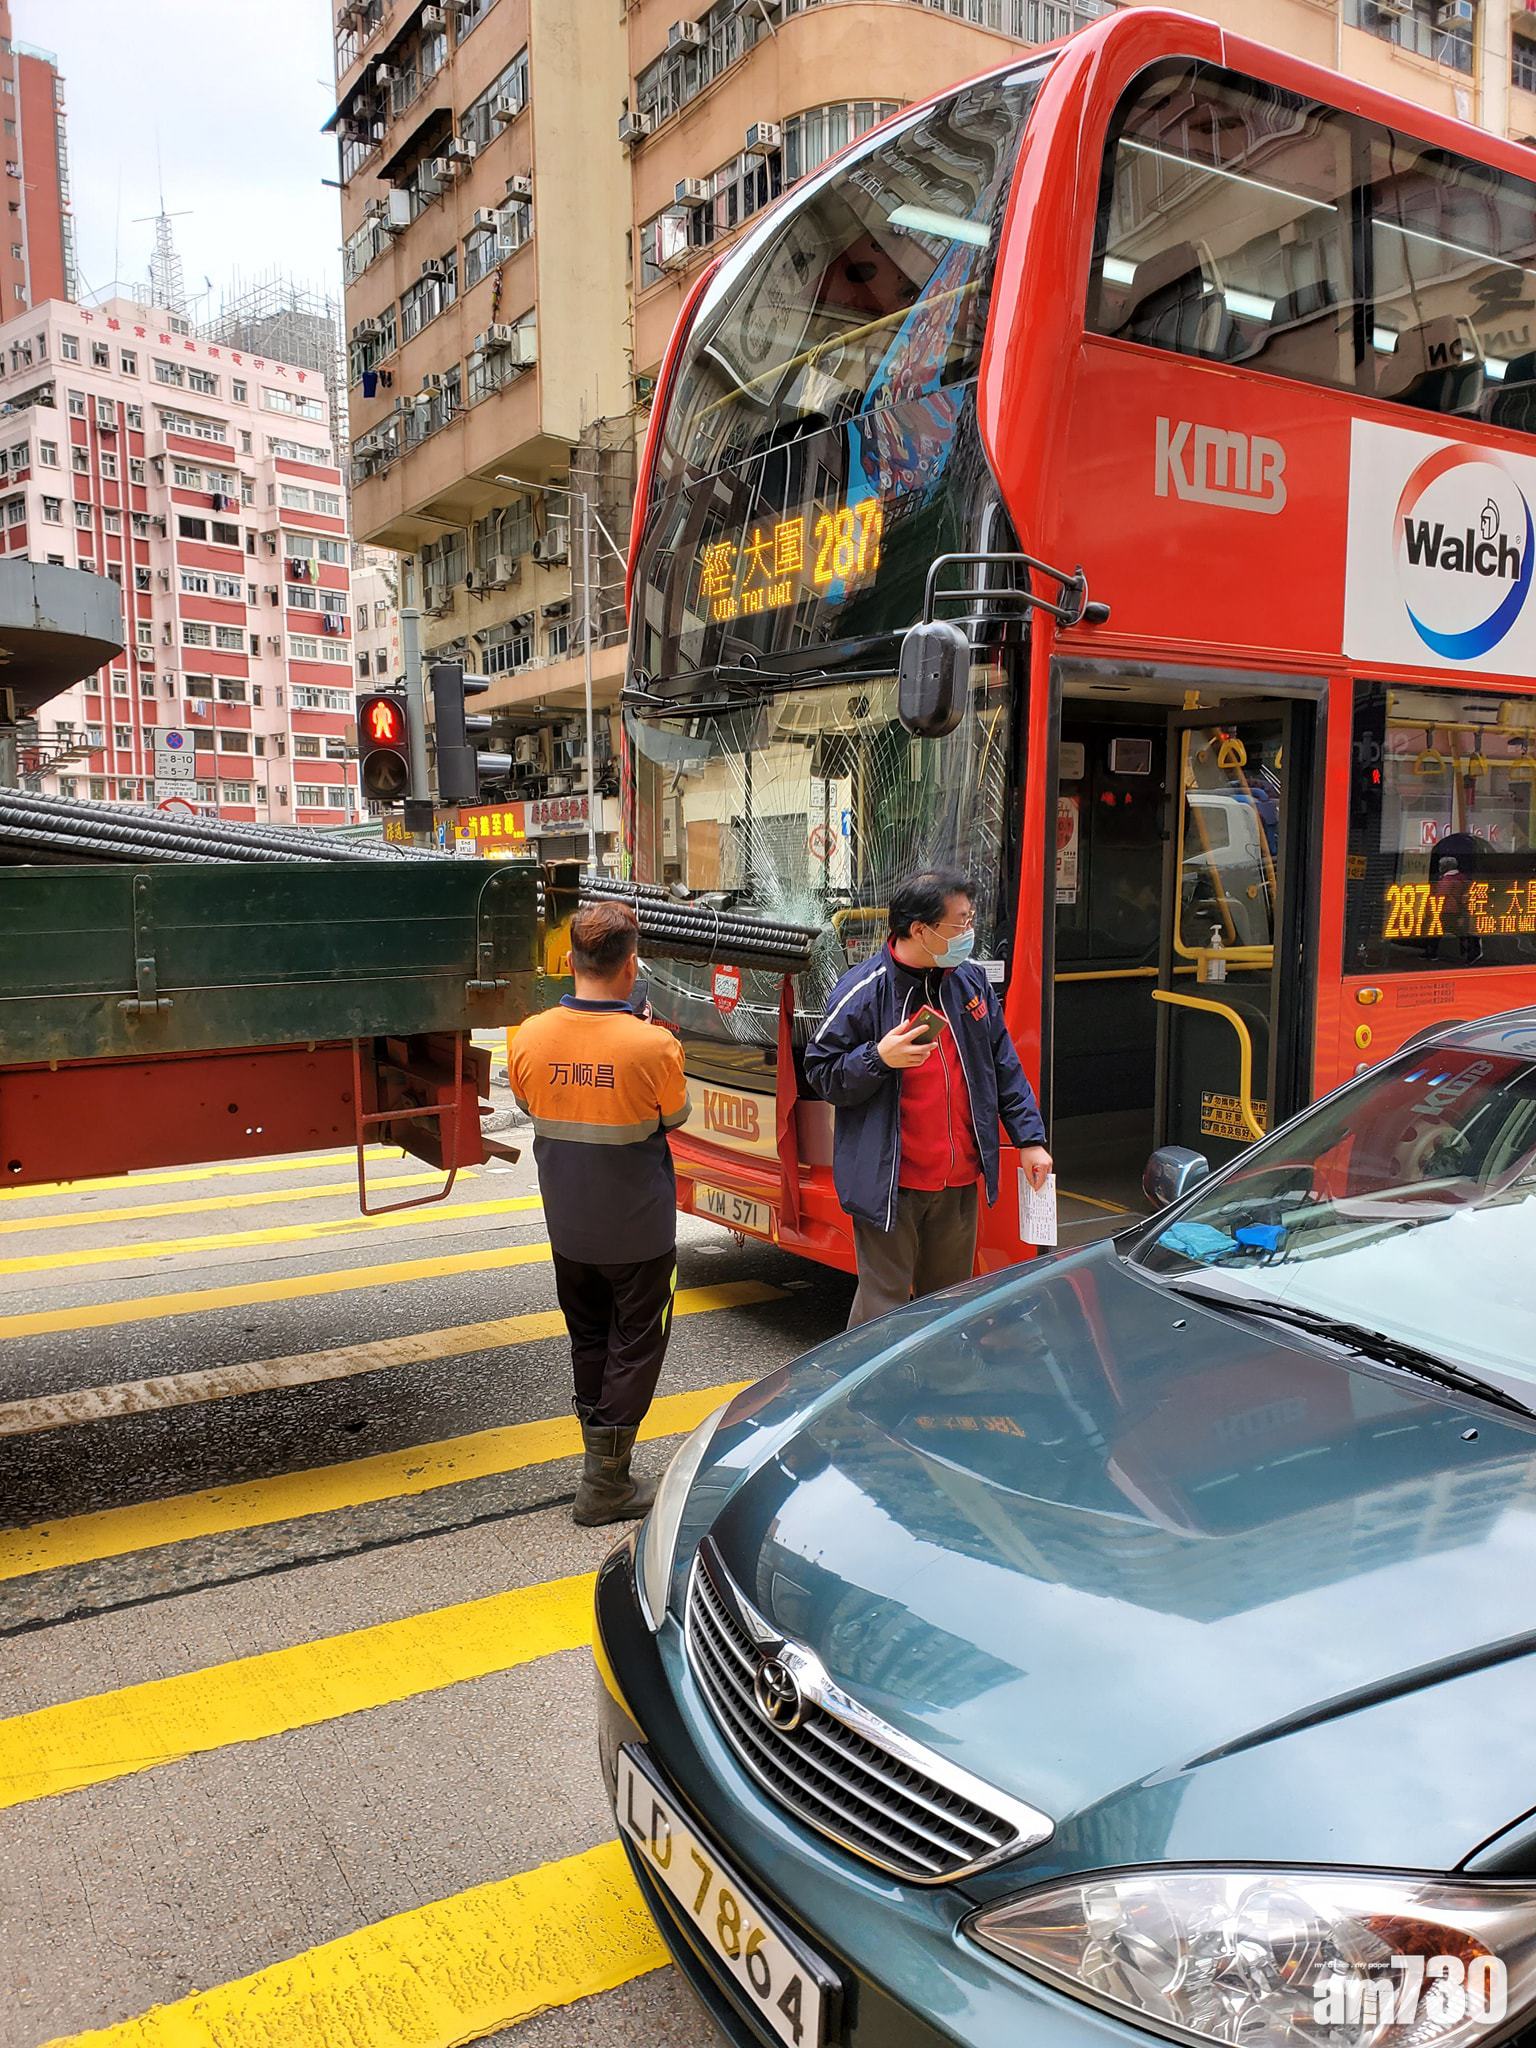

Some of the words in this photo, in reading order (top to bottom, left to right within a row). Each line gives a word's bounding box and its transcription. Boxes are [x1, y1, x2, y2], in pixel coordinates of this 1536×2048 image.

[1155, 416, 1287, 515] KMB
[1404, 517, 1521, 580] Walch
[742, 589, 765, 615] TAI
[768, 581, 793, 608] WAI
[1500, 916, 1516, 932] TAI
[549, 1062, 615, 1089] 万顺昌
[704, 1089, 760, 1142] KMB
[707, 1188, 726, 1214] VM
[733, 1197, 757, 1227] 571
[628, 1771, 672, 1870] LD
[691, 1847, 804, 2043] 7864
